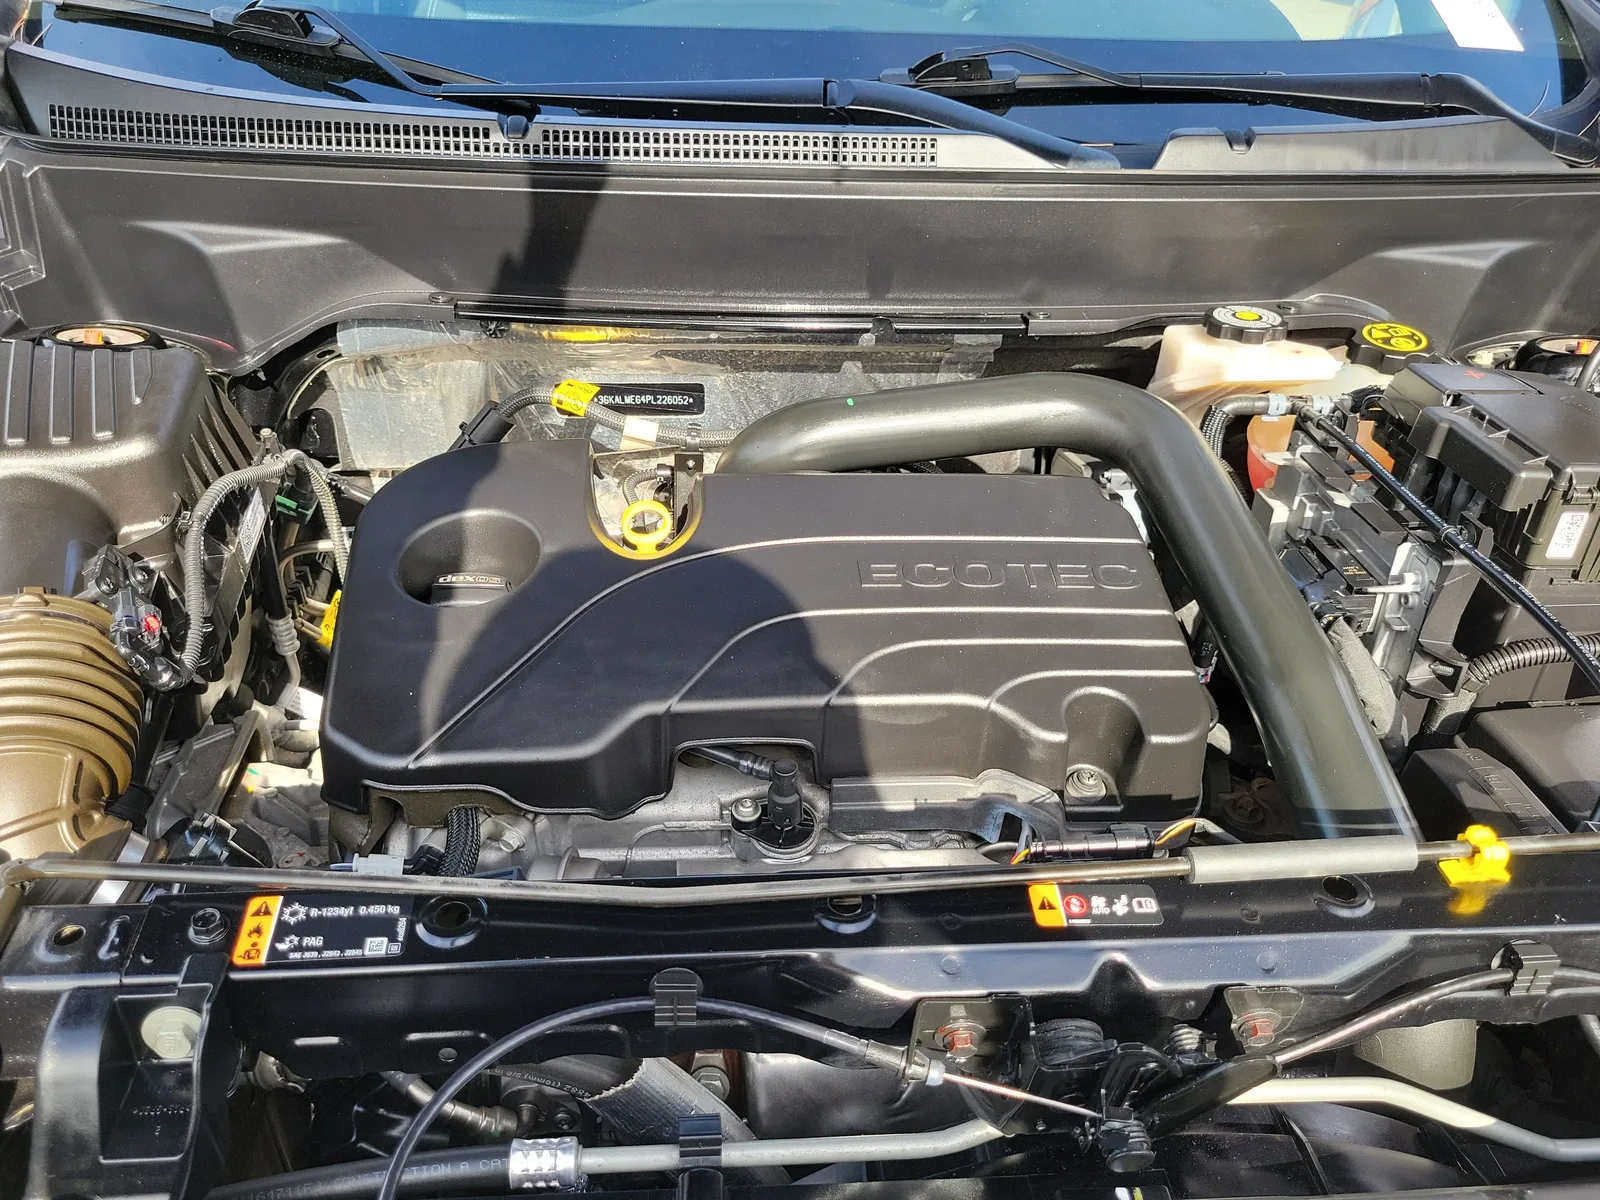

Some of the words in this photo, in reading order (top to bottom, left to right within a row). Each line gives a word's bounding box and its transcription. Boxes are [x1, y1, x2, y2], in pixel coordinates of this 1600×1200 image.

[438, 574, 501, 584] dexos
[857, 561, 1142, 589] ECOTEC
[310, 906, 354, 918] R-1234yf
[359, 905, 386, 915] 0.450
[387, 905, 400, 915] kg
[1092, 907, 1110, 915] AUTO
[302, 937, 324, 947] PAG
